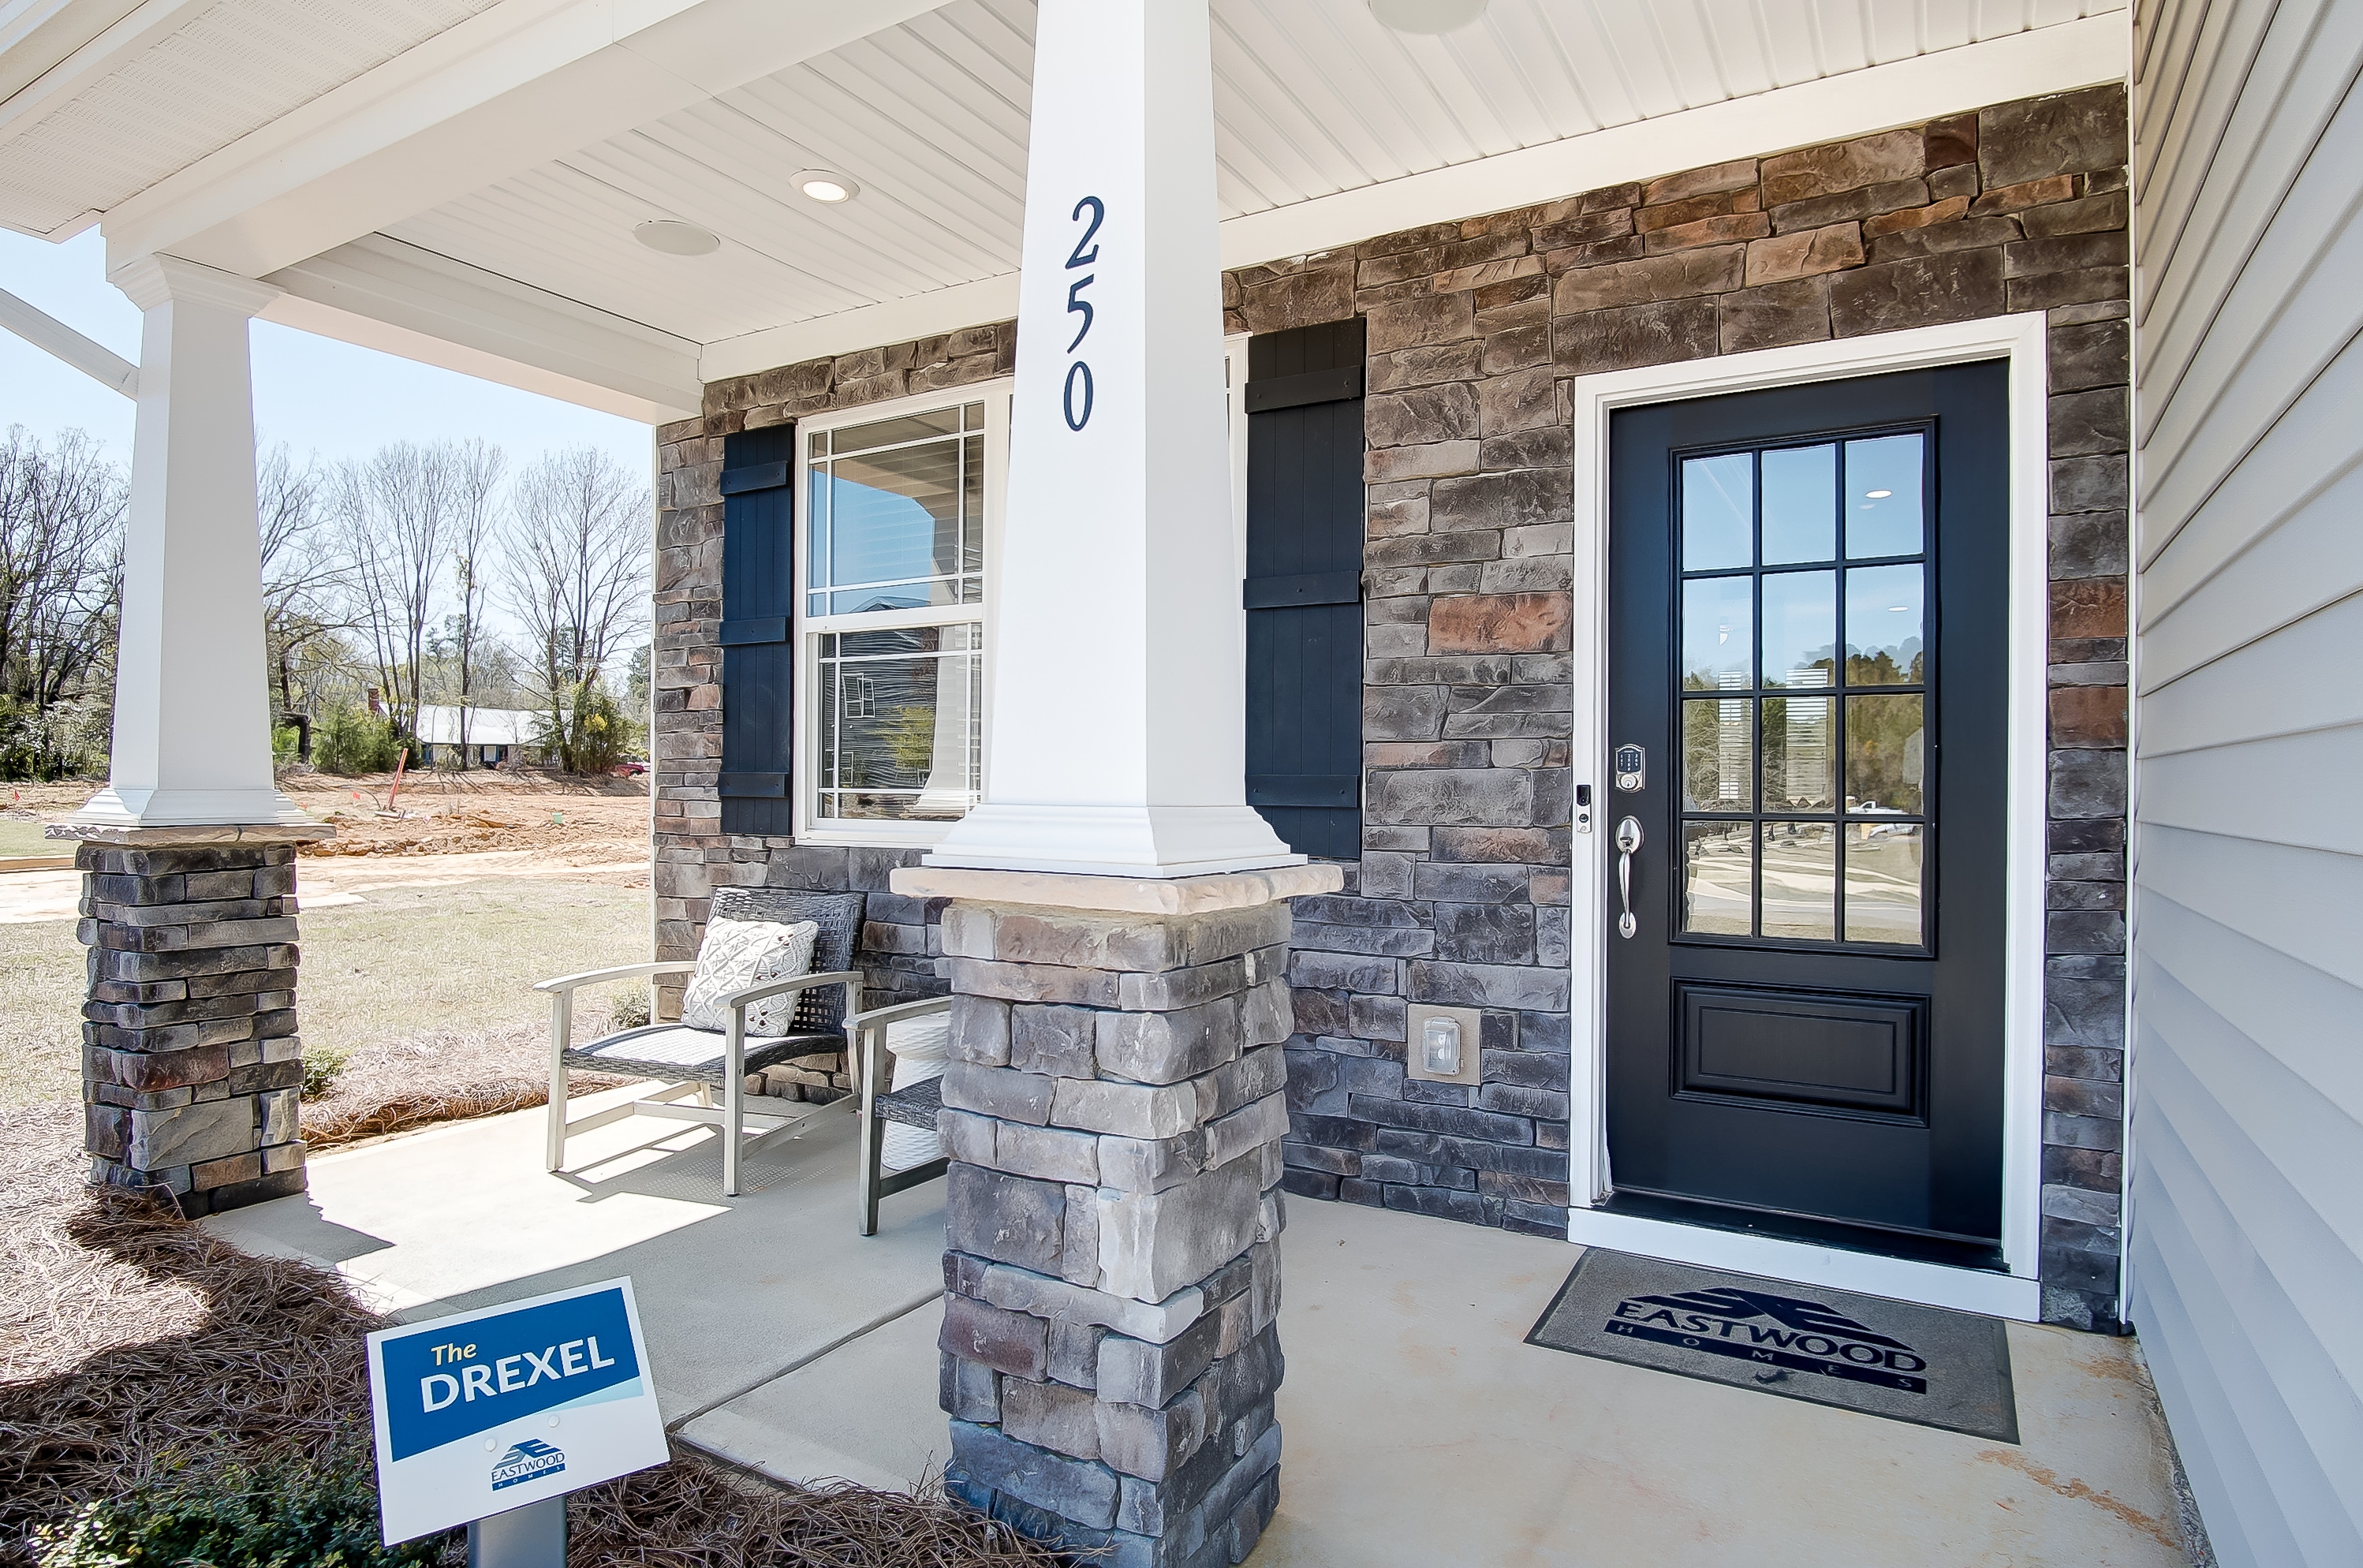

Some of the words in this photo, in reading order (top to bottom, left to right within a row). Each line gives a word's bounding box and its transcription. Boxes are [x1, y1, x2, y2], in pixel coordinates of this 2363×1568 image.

[1064, 196, 1104, 431] 250
[431, 1342, 477, 1366] The
[1614, 1301, 1926, 1372] EASTWOOD
[1617, 1324, 1913, 1388] HOMES
[420, 1336, 615, 1413] DREXEL
[491, 1452, 565, 1482] EASTWOOD
